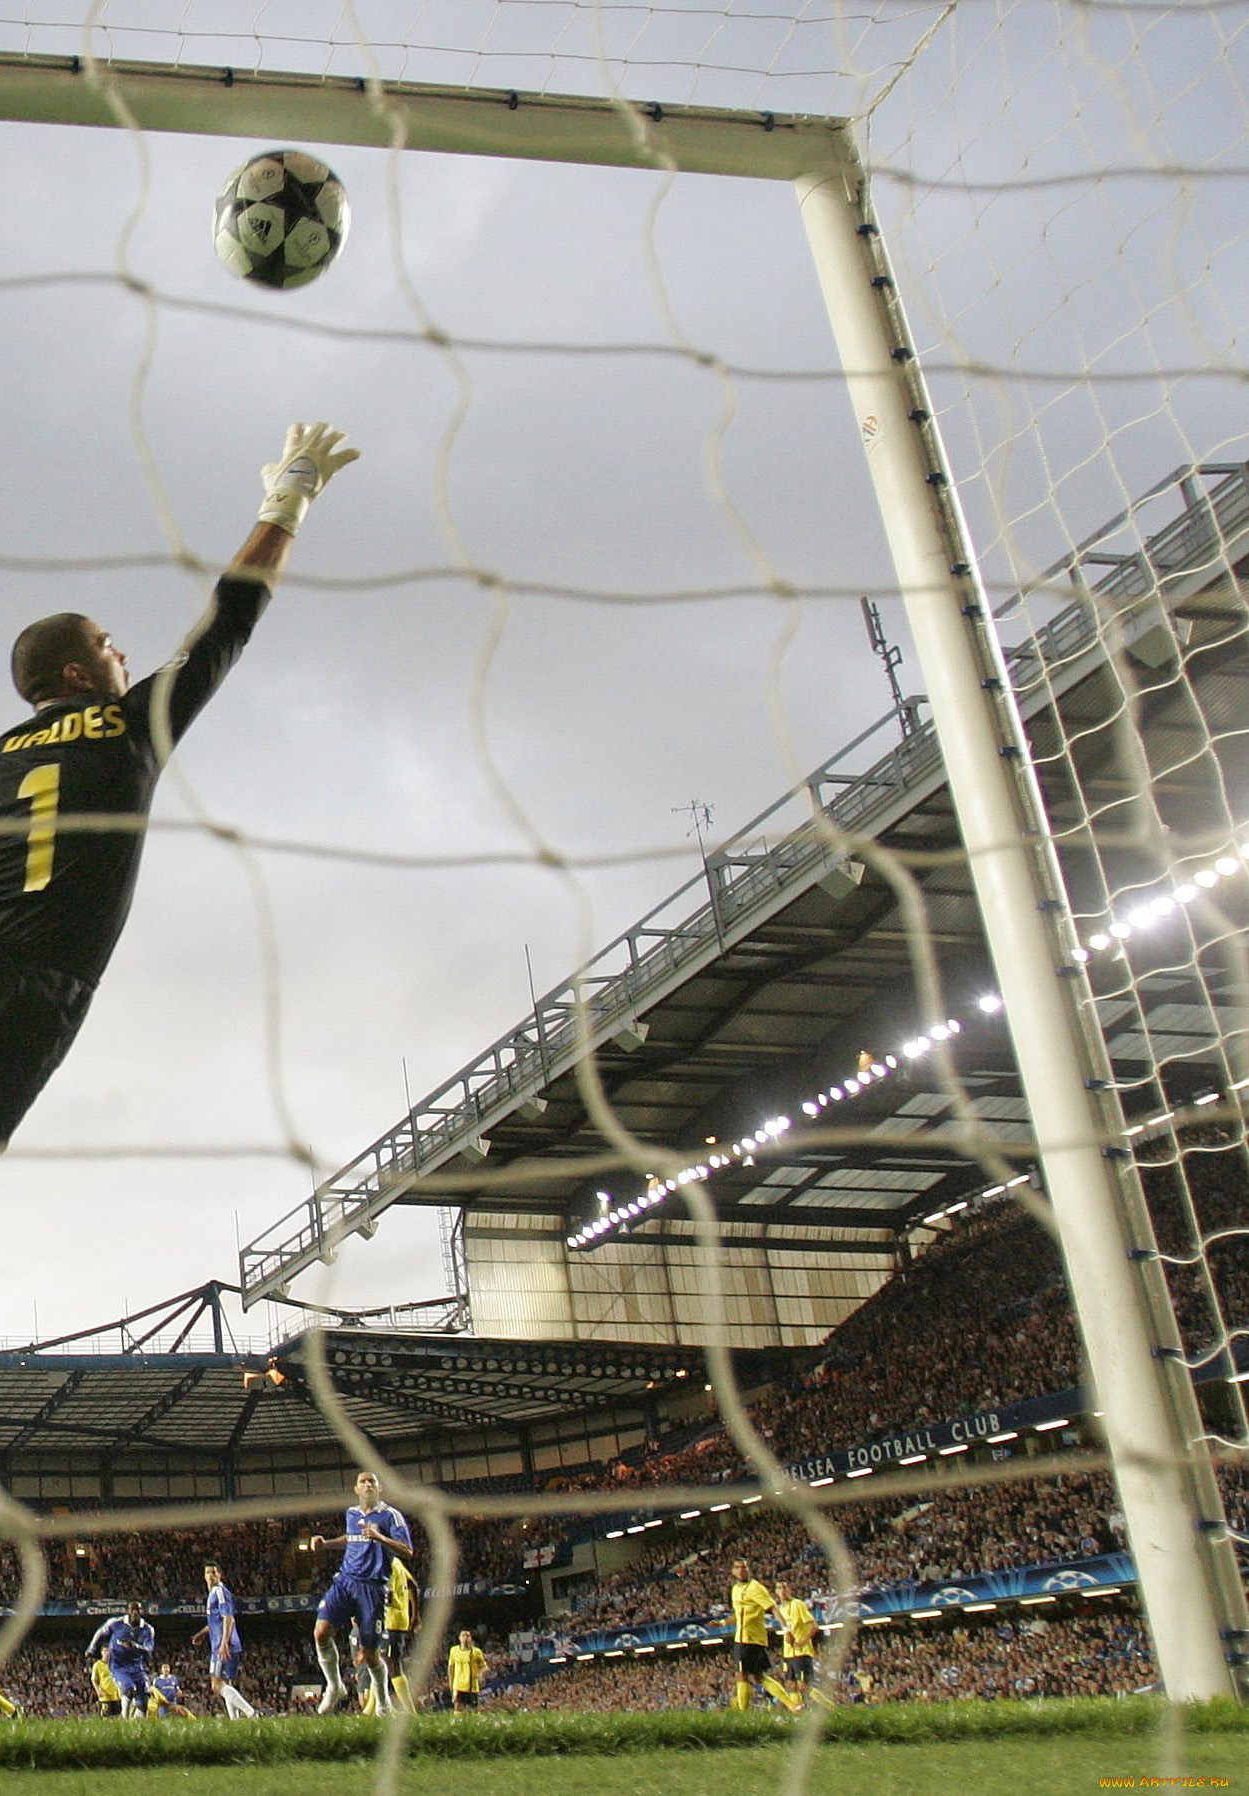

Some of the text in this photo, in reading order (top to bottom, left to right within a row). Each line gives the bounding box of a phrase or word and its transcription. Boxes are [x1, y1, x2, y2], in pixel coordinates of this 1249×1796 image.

[2, 704, 127, 753] VALDES
[17, 763, 60, 892] 1
[848, 1433, 936, 1467] FOOTBALL
[952, 1414, 1000, 1441] CLUB
